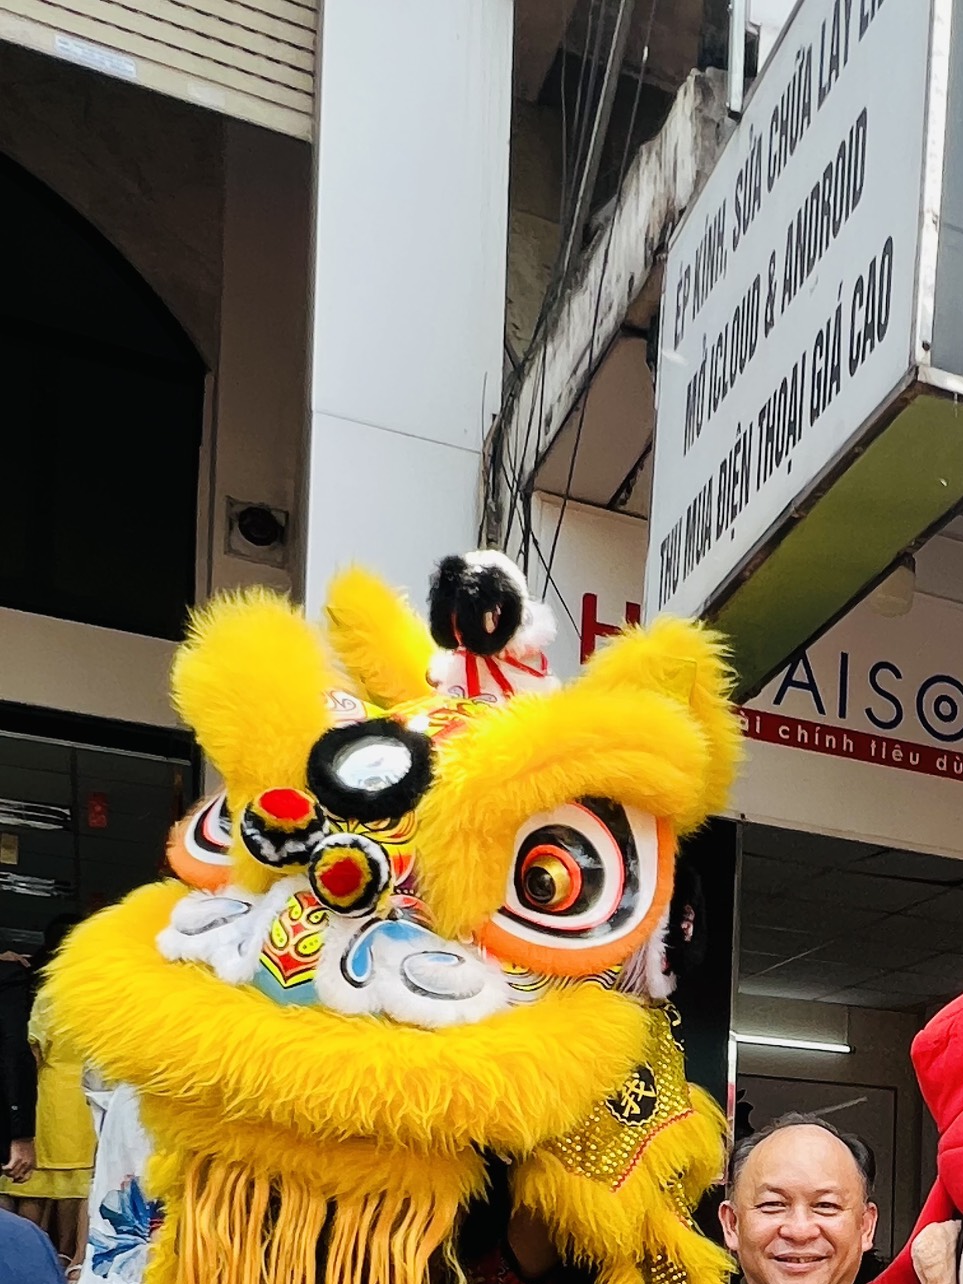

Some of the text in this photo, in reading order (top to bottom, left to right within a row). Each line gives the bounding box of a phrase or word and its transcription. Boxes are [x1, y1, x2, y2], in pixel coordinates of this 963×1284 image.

[684, 107, 867, 456] MỞ ICLOUD & ANDROID
[692, 198, 727, 321] KÍNH,
[733, 123, 761, 252] SỬA
[767, 43, 812, 192] CHỮA
[658, 235, 893, 611] THU MUA ĐIỆN THOẠI GIÁ CAO
[738, 709, 761, 735] ài
[778, 724, 854, 753] chính
